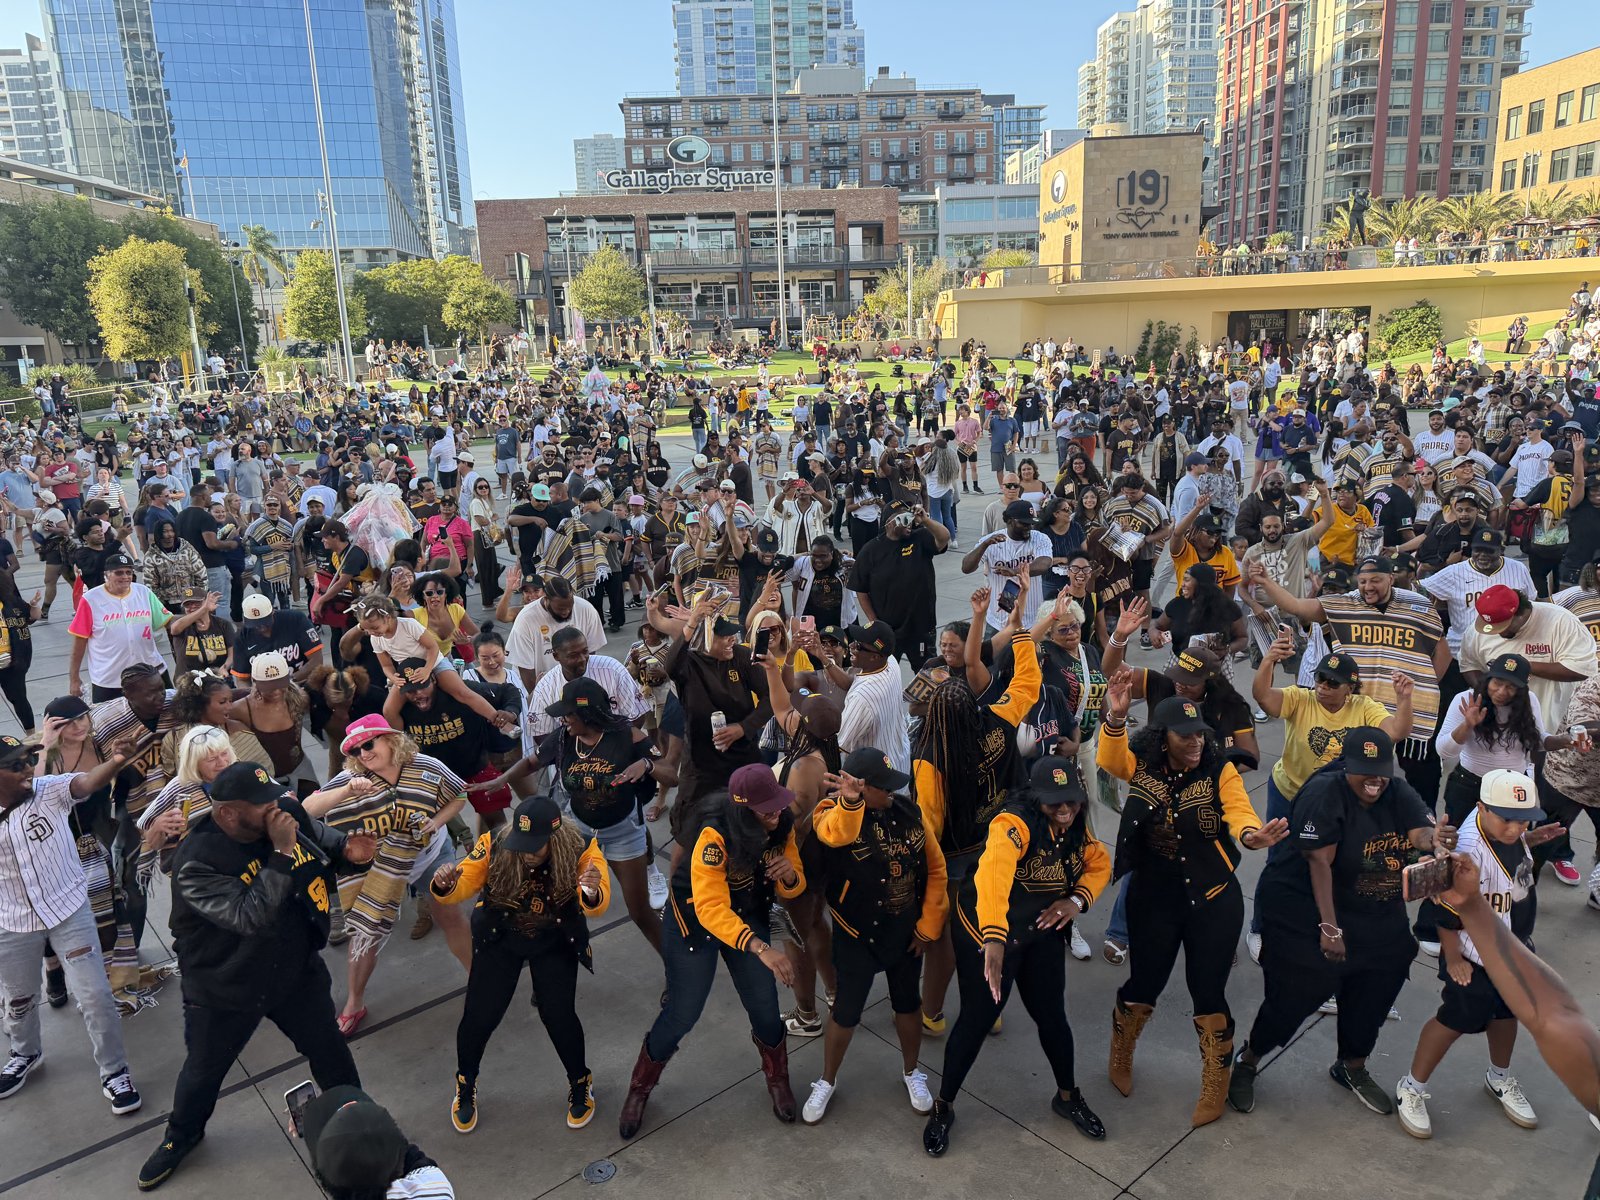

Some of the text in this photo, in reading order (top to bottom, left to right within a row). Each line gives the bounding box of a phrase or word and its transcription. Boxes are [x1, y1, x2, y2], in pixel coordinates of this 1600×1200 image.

[606, 169, 774, 191] Gallagher Square
[1127, 169, 1161, 205] 19
[1150, 230, 1180, 238] TERRACE
[1250, 318, 1286, 328] HALL OF FAME
[1025, 398, 1033, 408] 3
[1421, 441, 1450, 452] PADRES
[103, 610, 151, 623] SAN DIEGO
[142, 626, 152, 640] 4
[1350, 623, 1416, 650] PADRES
[187, 635, 226, 651] PARES
[1186, 654, 1205, 669] DIEGO
[1076, 673, 1107, 683] TEY
[409, 717, 464, 735] INSPIRE
[568, 762, 616, 776] HERITAGE
[1512, 785, 1527, 803] SD
[26, 813, 54, 843] SD
[1363, 836, 1413, 860] HERITAGE
[704, 854, 720, 863] 2024
